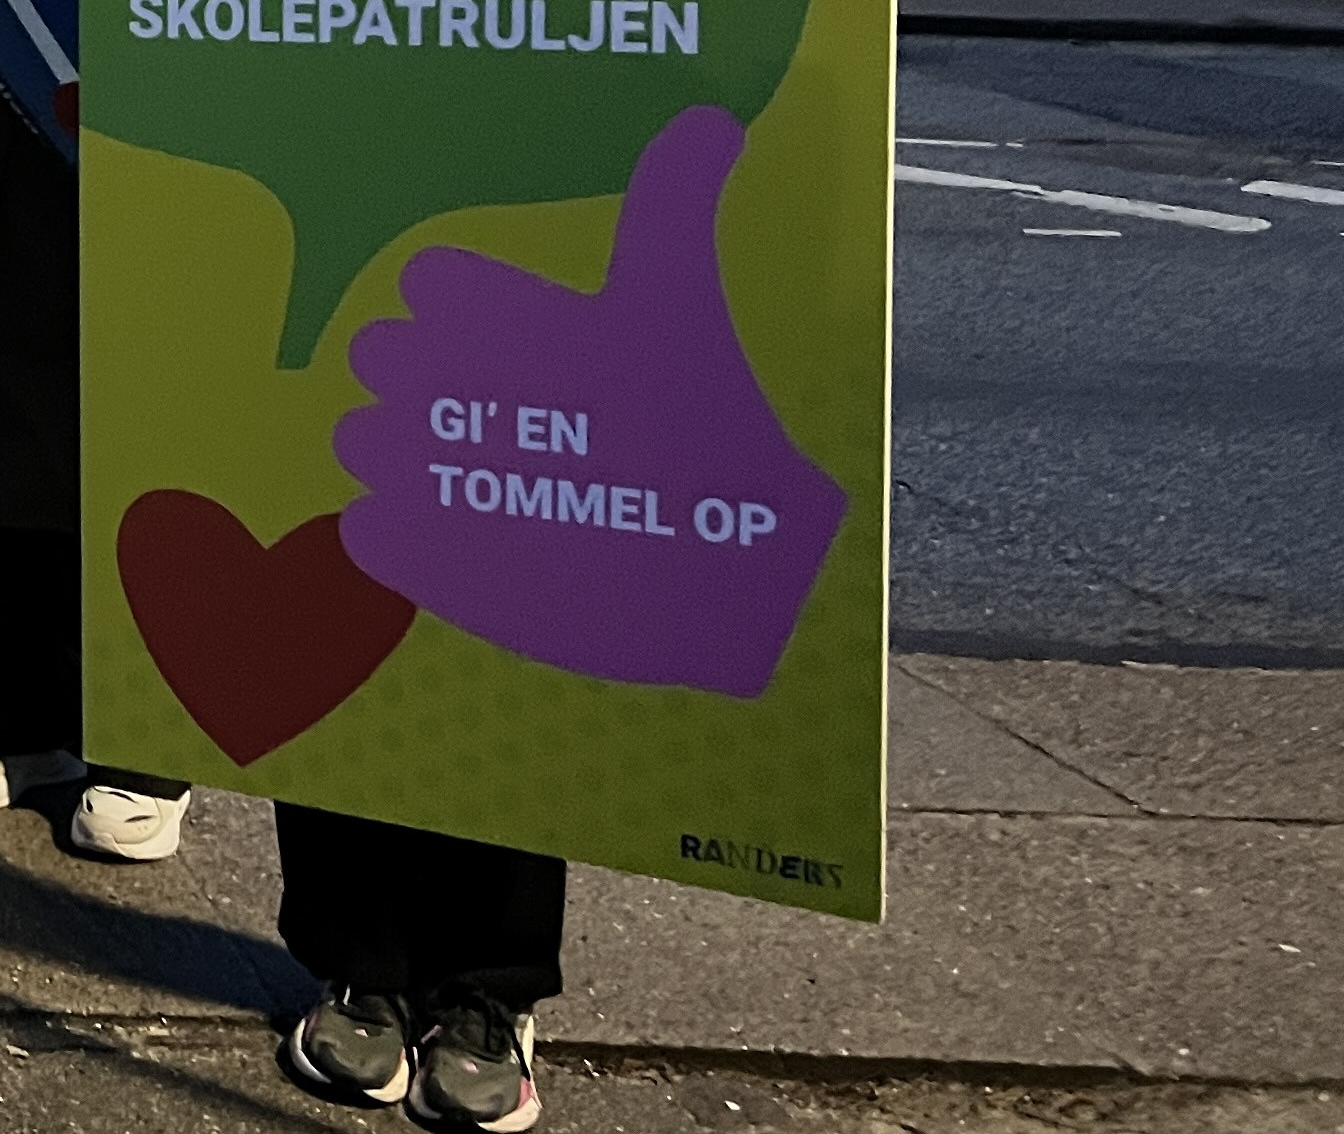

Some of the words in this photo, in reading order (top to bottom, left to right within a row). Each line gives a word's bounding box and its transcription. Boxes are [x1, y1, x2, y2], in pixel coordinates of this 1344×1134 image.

[517, 406, 588, 456] EN
[428, 464, 675, 536] TOMMEL
[694, 498, 777, 546] OP
[680, 833, 845, 889] RANDERS
